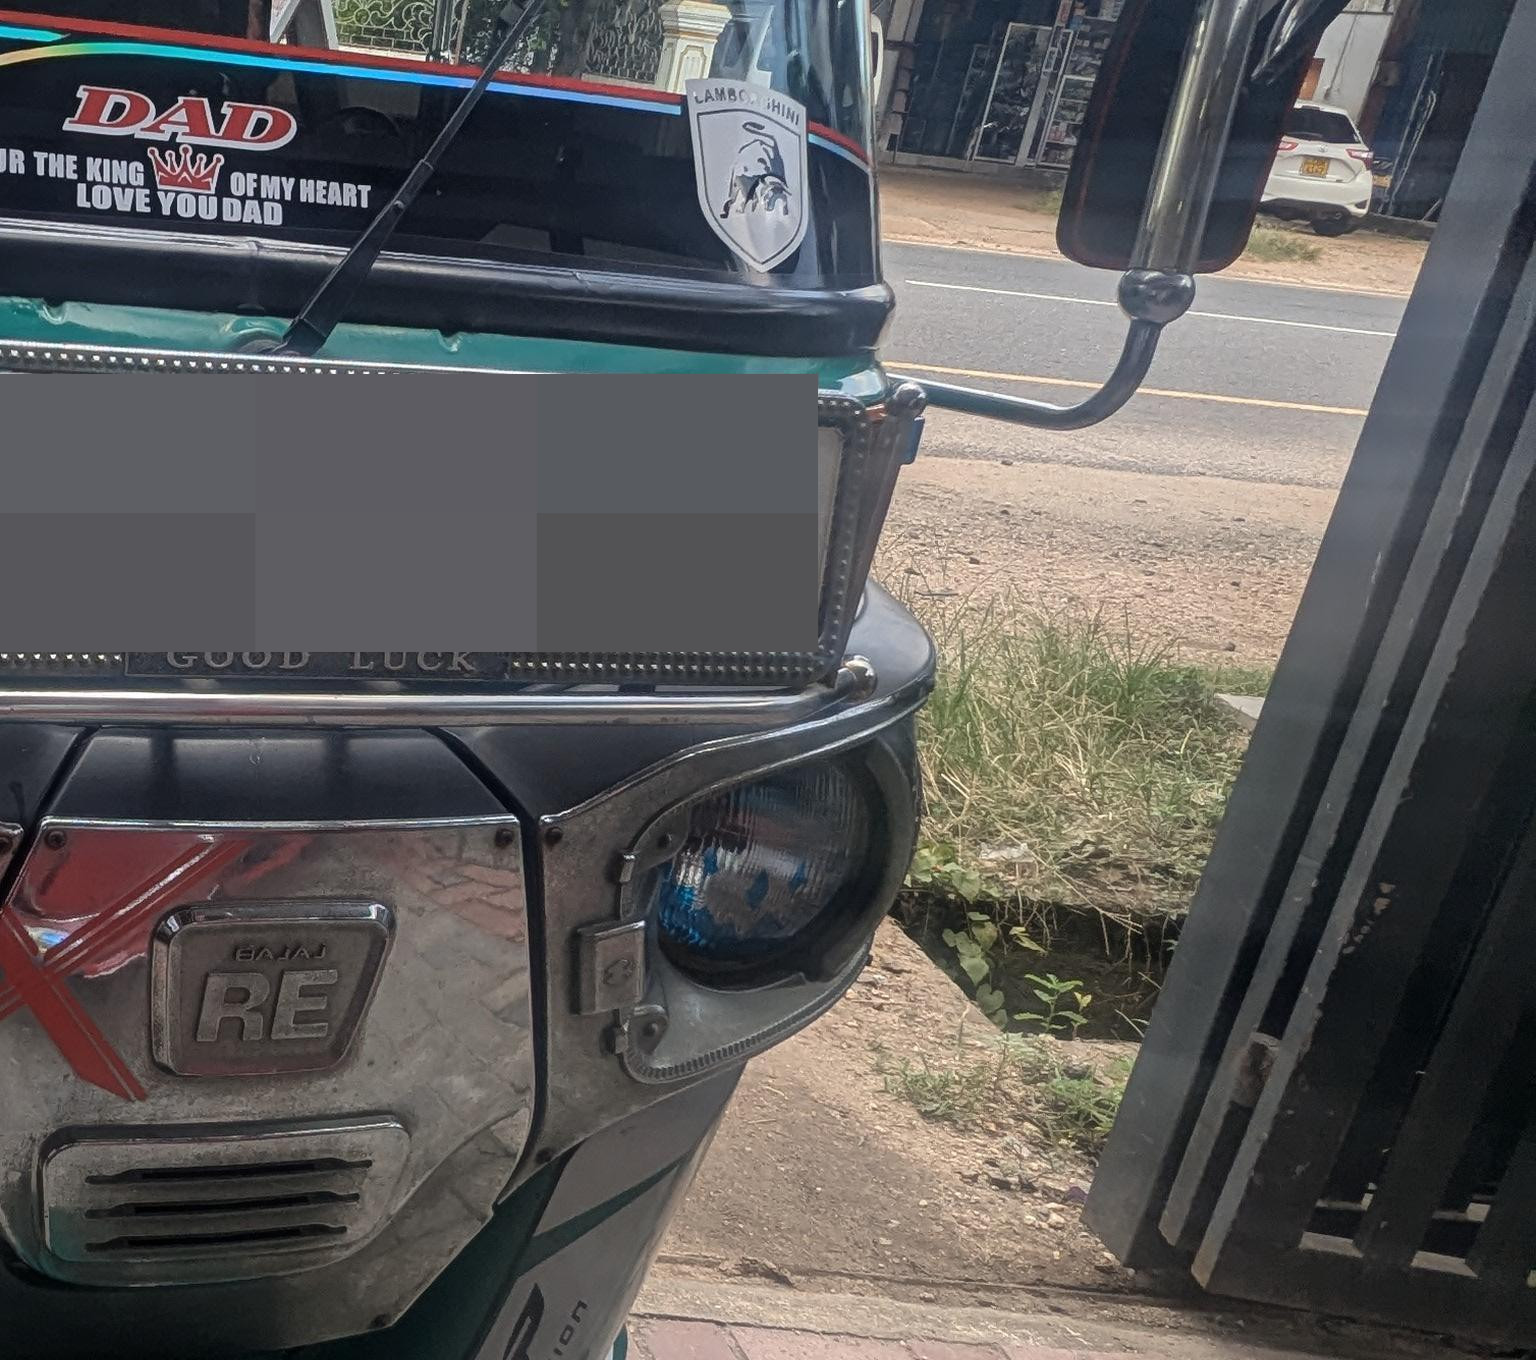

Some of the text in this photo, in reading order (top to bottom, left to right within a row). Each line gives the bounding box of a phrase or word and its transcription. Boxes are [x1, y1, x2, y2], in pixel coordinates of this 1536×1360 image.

[62, 84, 297, 152] DAD
[693, 86, 800, 127] LAMBOHINI
[33, 149, 78, 182] THE
[85, 155, 145, 189] KING
[230, 170, 260, 199] OF
[261, 172, 296, 203] MY
[299, 177, 372, 210] HEART
[76, 183, 283, 227] LOVE YOU DAD
[166, 651, 477, 672] GOOD LUCK
[235, 944, 326, 962] BAJAJ
[196, 968, 338, 1042] RE
